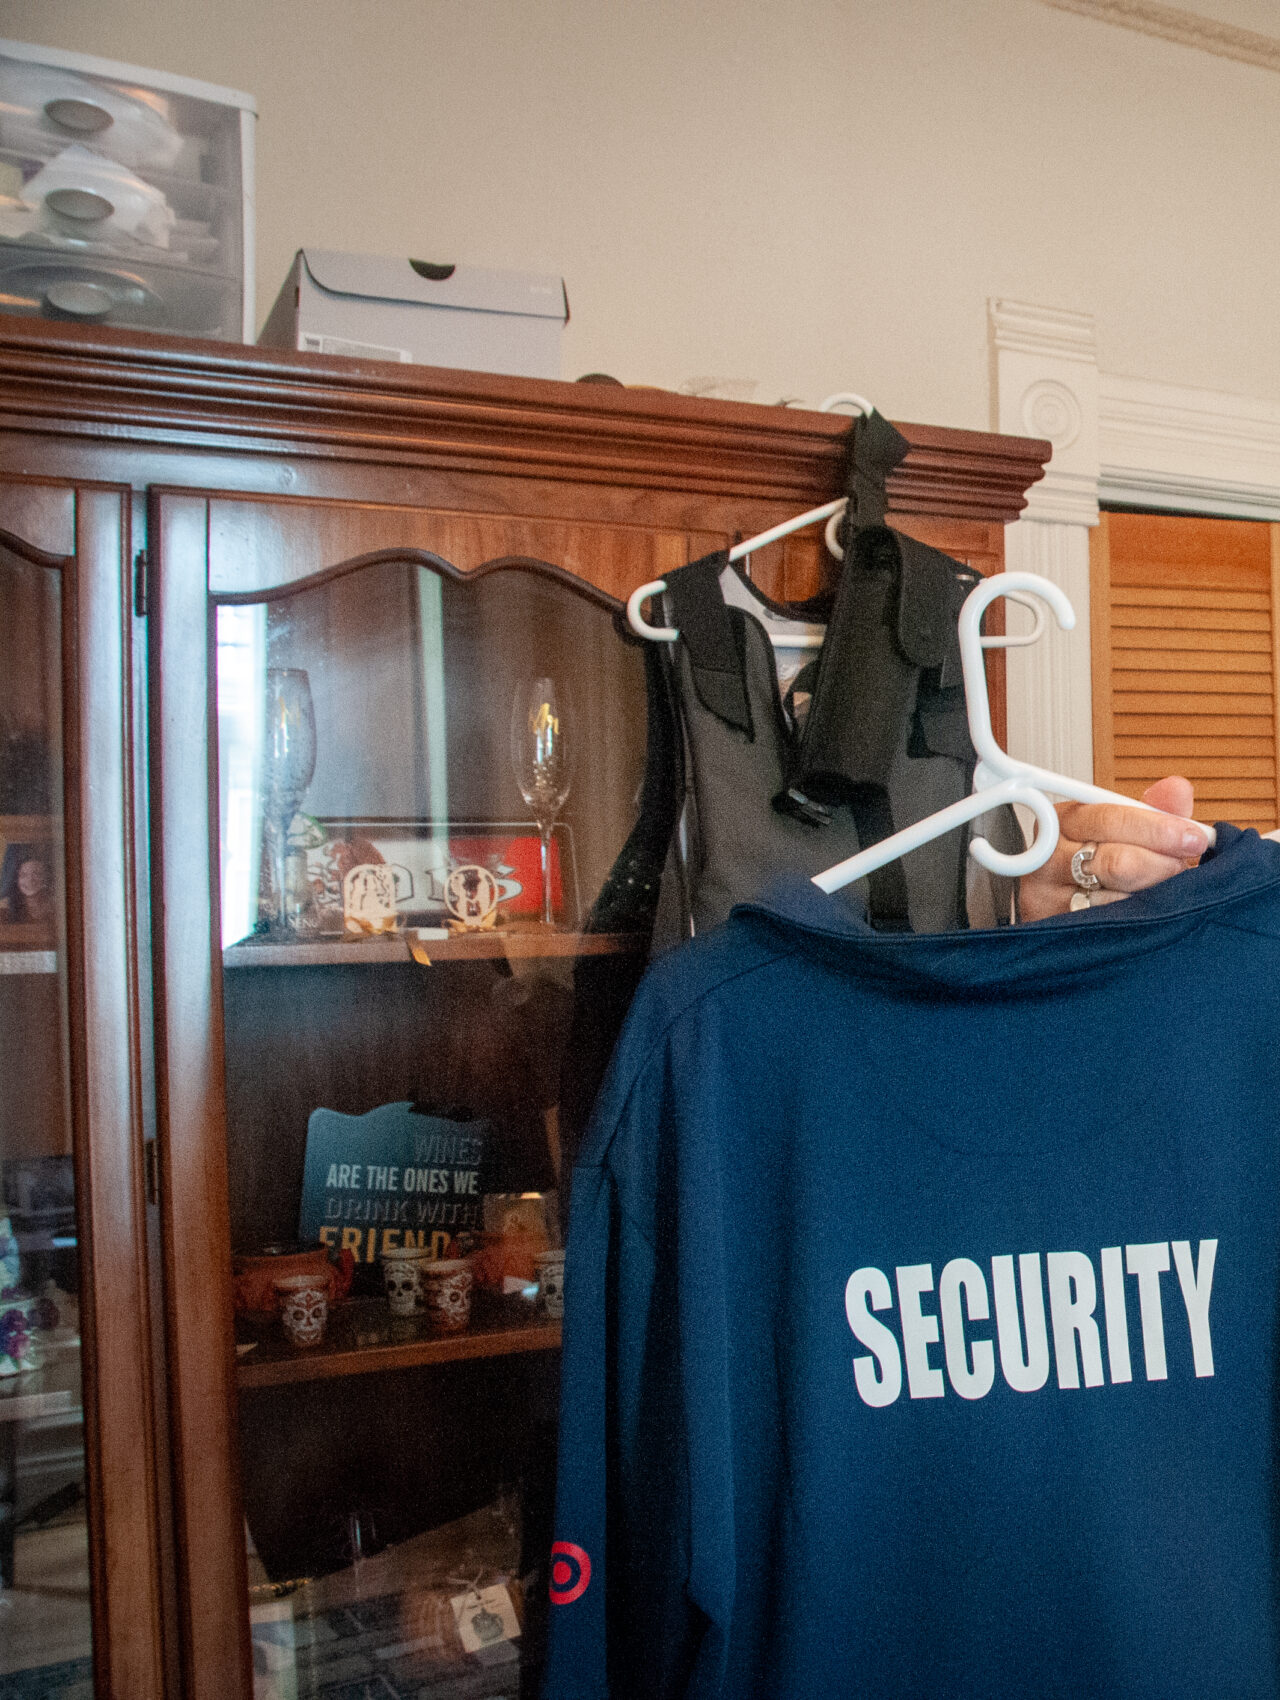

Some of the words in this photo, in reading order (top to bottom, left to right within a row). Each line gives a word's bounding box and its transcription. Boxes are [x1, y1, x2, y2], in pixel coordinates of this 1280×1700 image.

[326, 1163, 362, 1189] ARE
[366, 1165, 399, 1191] THE
[402, 1167, 449, 1192] ONES
[453, 1170, 479, 1195] WE
[325, 1197, 408, 1222] DRINK
[417, 1200, 478, 1226] WITH
[845, 1239, 1219, 1408] SECURITY
